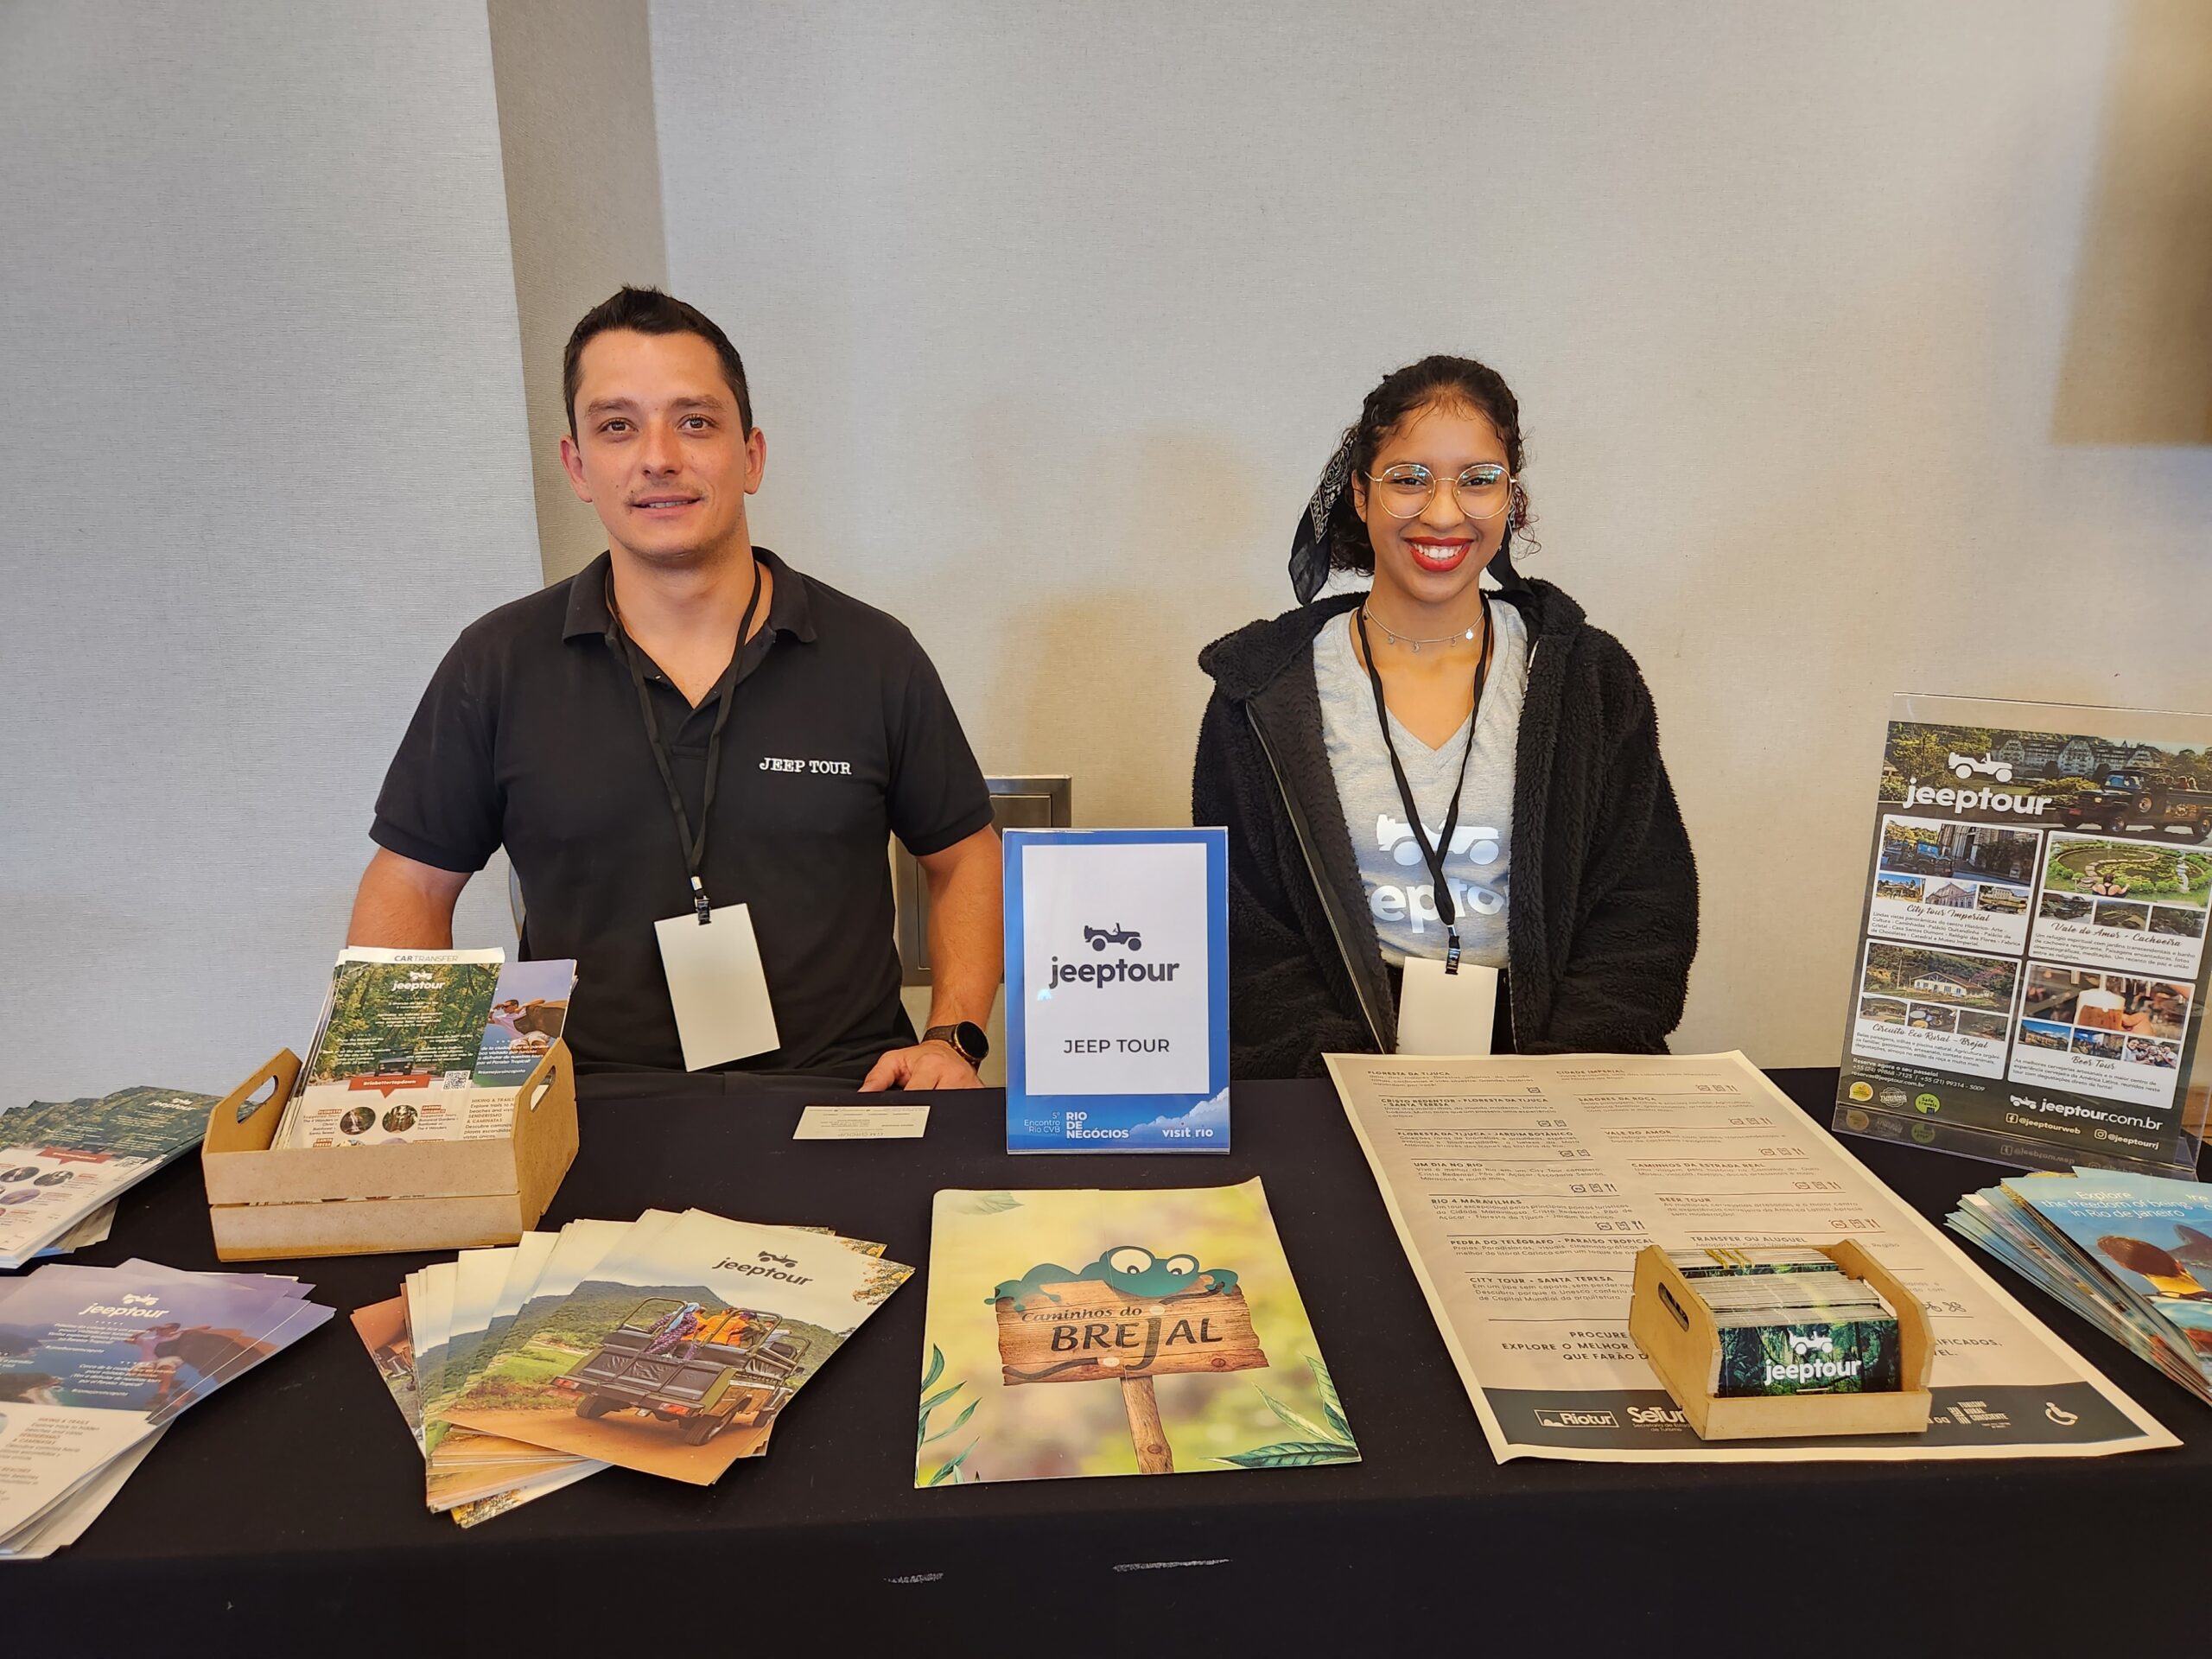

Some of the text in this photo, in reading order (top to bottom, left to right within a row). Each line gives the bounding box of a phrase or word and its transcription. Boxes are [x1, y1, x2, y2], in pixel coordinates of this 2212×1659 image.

[759, 757, 852, 774] JEEP TOUR
[1903, 778, 2052, 816] jeeptour
[1906, 904, 1924, 917] City
[1947, 909, 1991, 922] Imperial
[2050, 922, 2183, 947] Vale do Amor Cachoeira
[1049, 956, 1179, 989] jeeptour
[391, 981, 445, 991] jeeptour
[1872, 1023, 1989, 1050] Circuito Eco Rural Brejal
[1064, 1039, 1170, 1054] JEEP TOUR
[1853, 1058, 1877, 1066] Reserve
[2071, 1055, 2115, 1070] Beer Tour
[1946, 1080, 1964, 1089] 99314
[1065, 1111, 1087, 1121] RIO
[2039, 1098, 2163, 1131] jeeptour.com.br
[1066, 1121, 1083, 1129] DE
[1162, 1128, 1214, 1138] visit rio
[2018, 1117, 2082, 1135] @jeeptourweb
[1066, 1128, 1129, 1139] NEGÓCIOS
[2107, 1133, 2159, 1150] @jeeptourrj
[2075, 1191, 2134, 1201] Explore
[2041, 1199, 2069, 1209] the
[2067, 1199, 2132, 1209] freedom
[2133, 1199, 2148, 1208] of
[2148, 1199, 2193, 1211] being
[2069, 1209, 2184, 1219] in Rio de Janeiro
[712, 1257, 813, 1285] jeeptour
[78, 1302, 170, 1318] jeeptour
[1021, 1306, 1142, 1322] Caminhos do
[1051, 1317, 1224, 1371] BREJAL
[1764, 1358, 1862, 1386] jeeptour
[1560, 1413, 1611, 1426] Riotur
